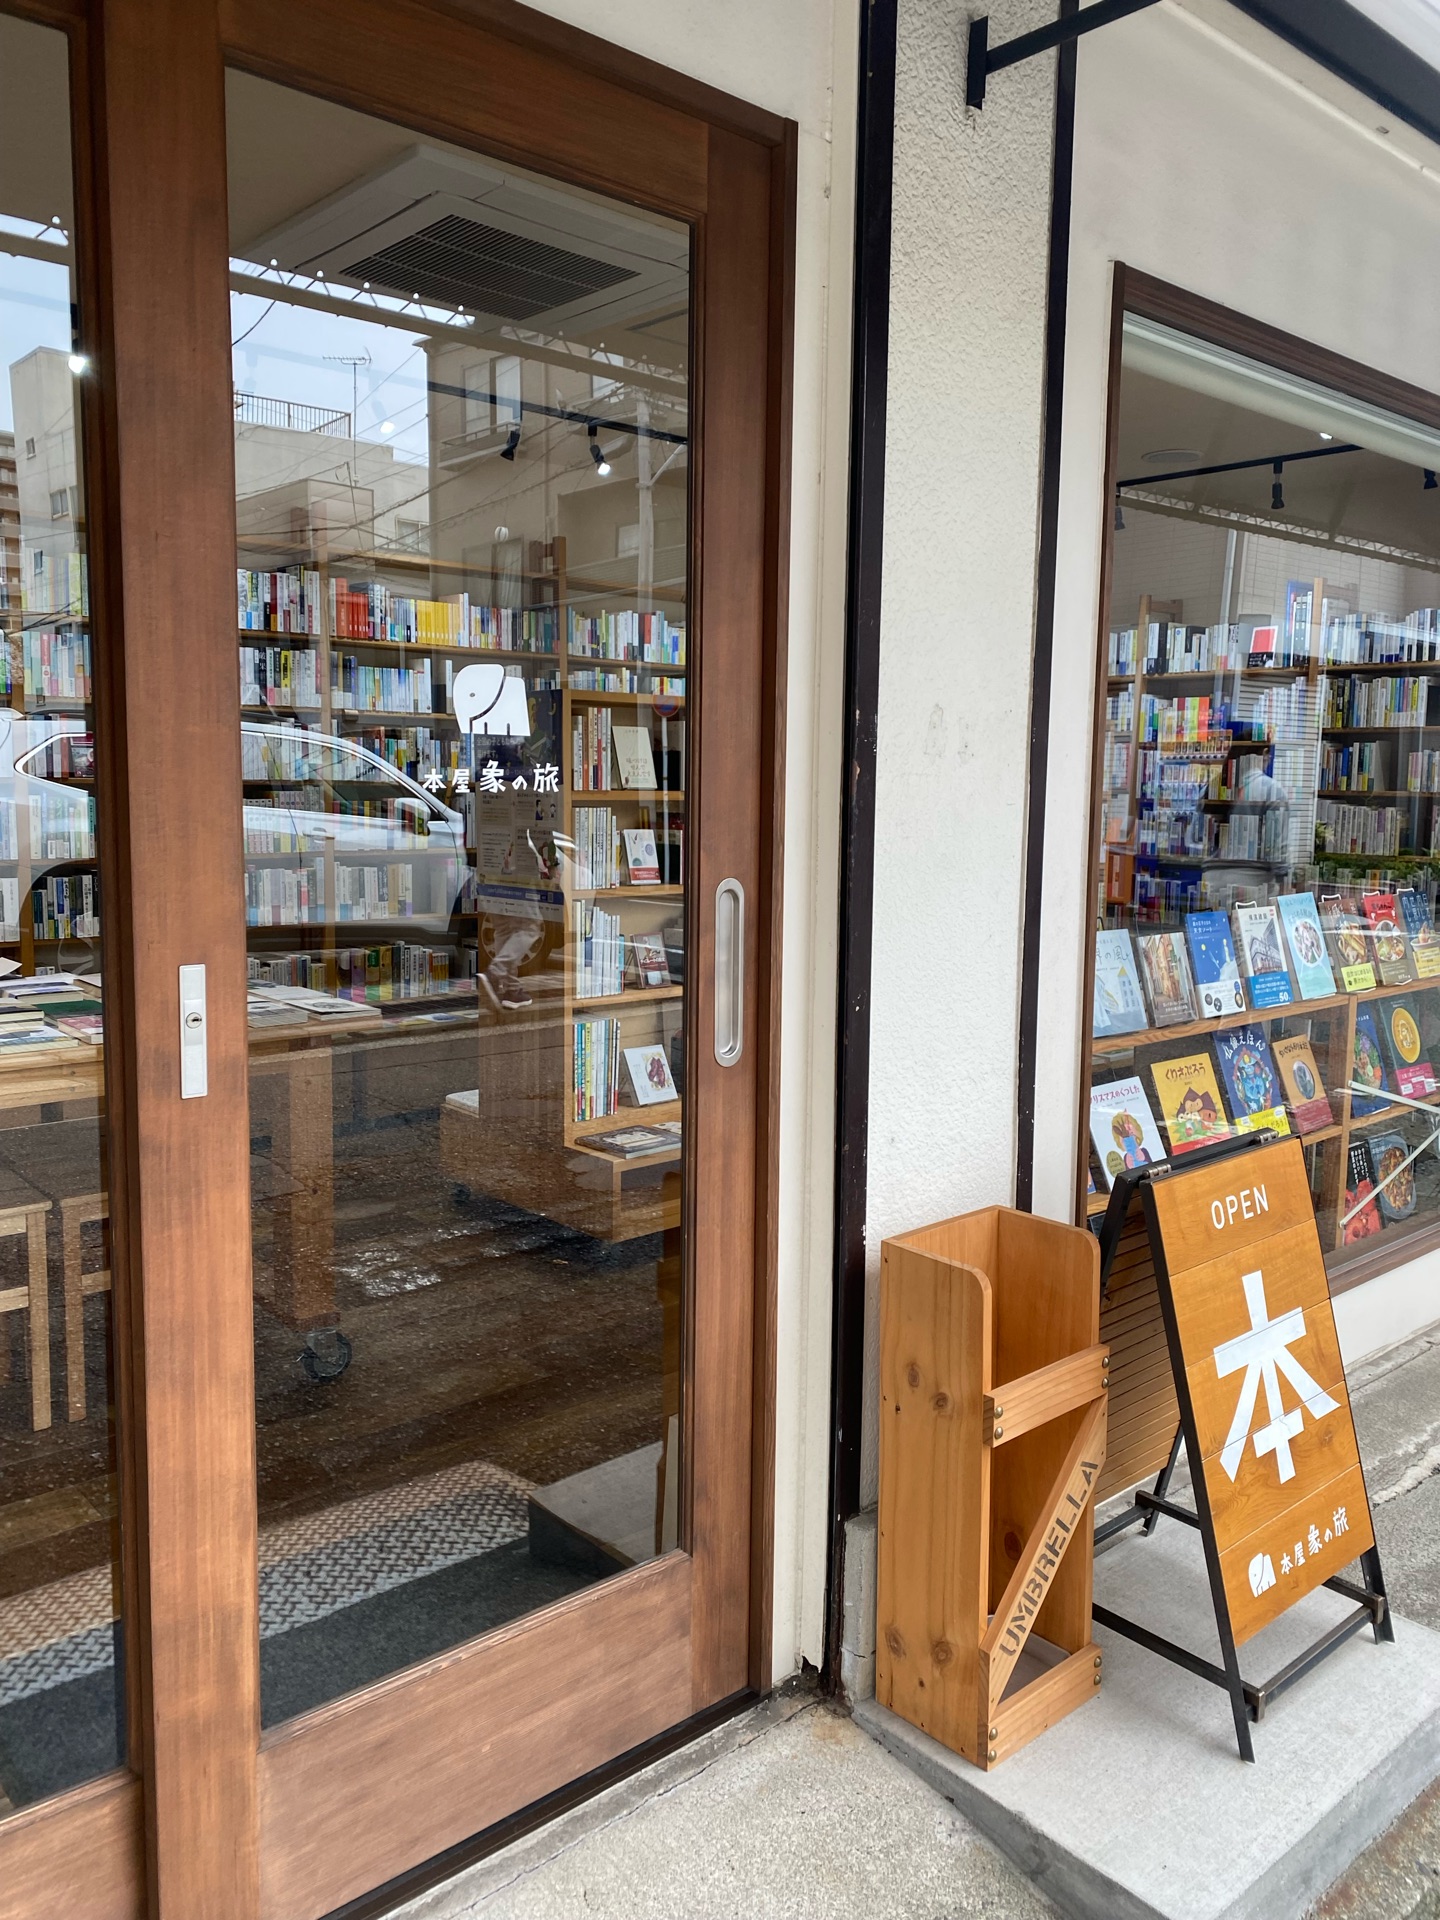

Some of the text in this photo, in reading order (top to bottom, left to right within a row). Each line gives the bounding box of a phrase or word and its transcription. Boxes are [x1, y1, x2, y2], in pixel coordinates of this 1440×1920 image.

[422, 760, 560, 794] 本屋象の旅
[1278, 991, 1289, 1002] 50
[1165, 1062, 1206, 1081] くりさぶろう
[1090, 1084, 1141, 1104] リスマスのくつした
[1210, 1184, 1271, 1230] OPEN
[1212, 1269, 1342, 1485] 本
[999, 1460, 1100, 1658] UMBRELLA
[1279, 1506, 1350, 1576] 本屋象の旅
